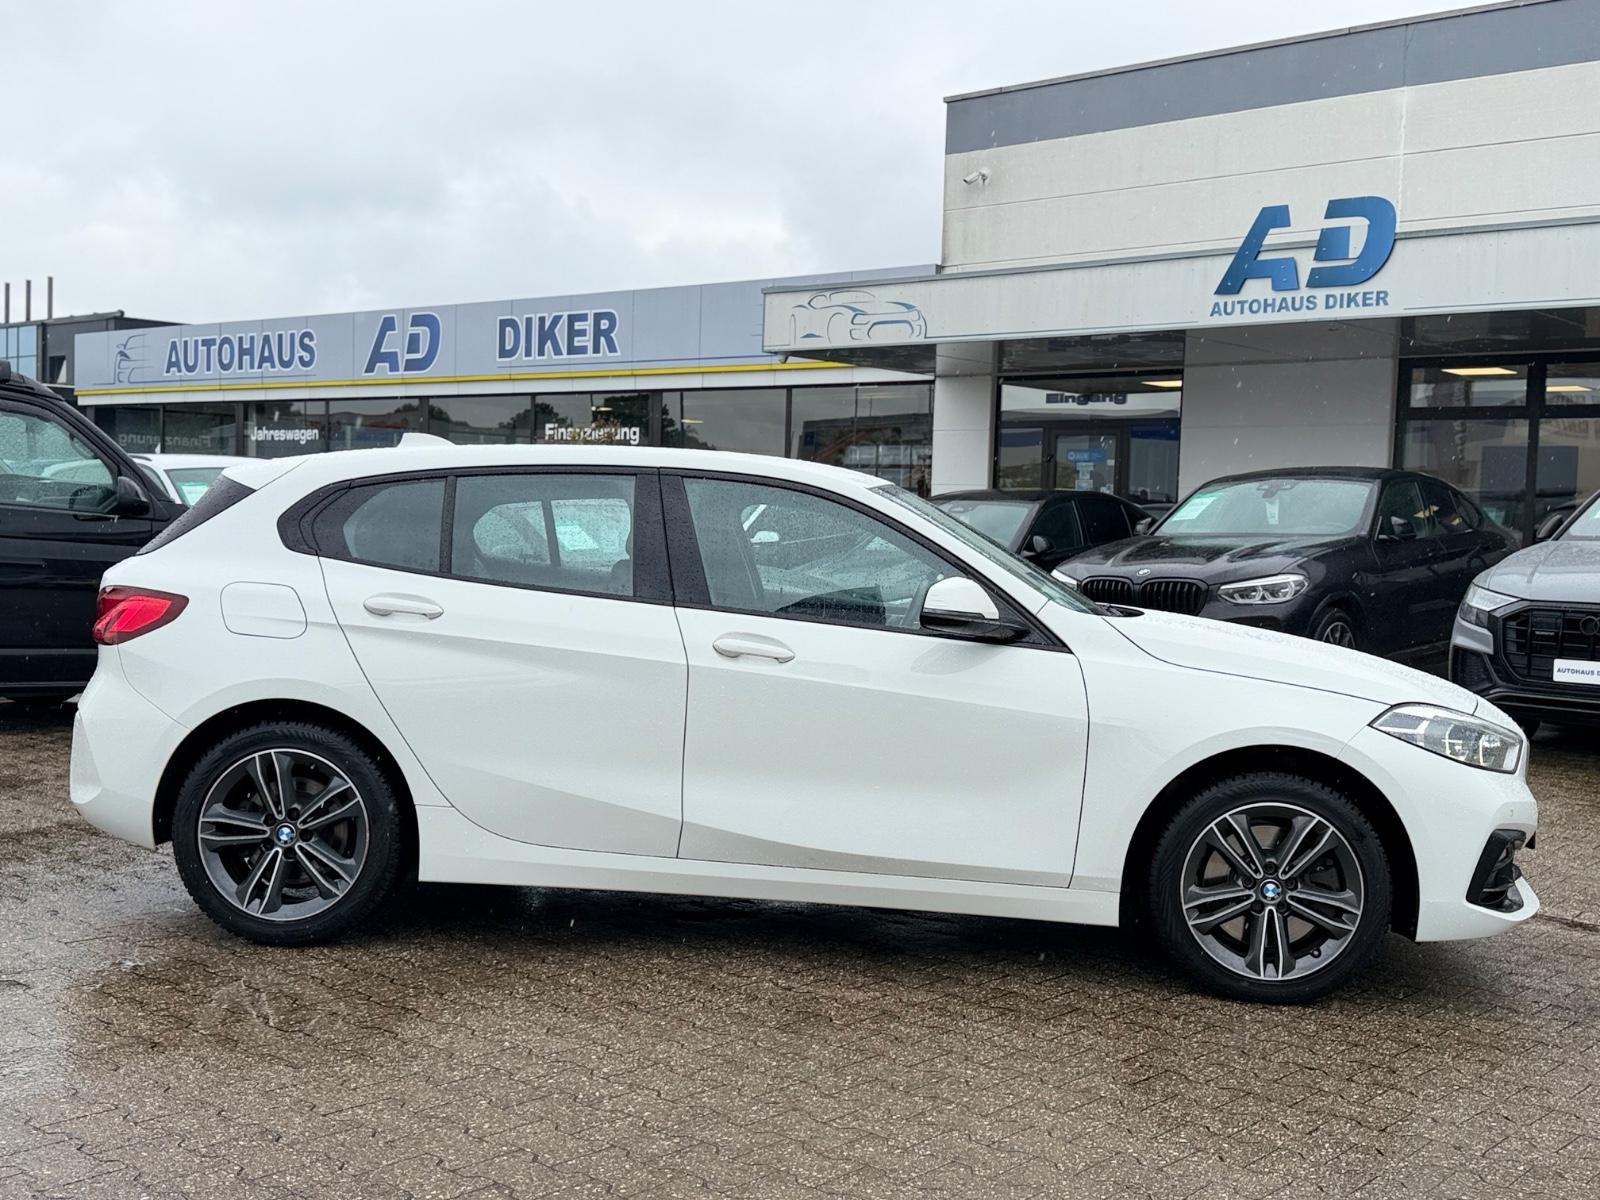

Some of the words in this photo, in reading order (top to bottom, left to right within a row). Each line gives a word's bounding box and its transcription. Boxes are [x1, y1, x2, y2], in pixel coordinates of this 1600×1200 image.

[1213, 196, 1397, 295] AD
[1209, 294, 1318, 318] AUTOHAUS
[1324, 289, 1390, 310] DIKER
[164, 329, 317, 376] AUTOHAUS
[362, 312, 441, 376] AD
[497, 308, 621, 361] DIKER
[250, 425, 320, 445] Jahreswagen
[1557, 667, 1595, 676] AUTOHAUS
